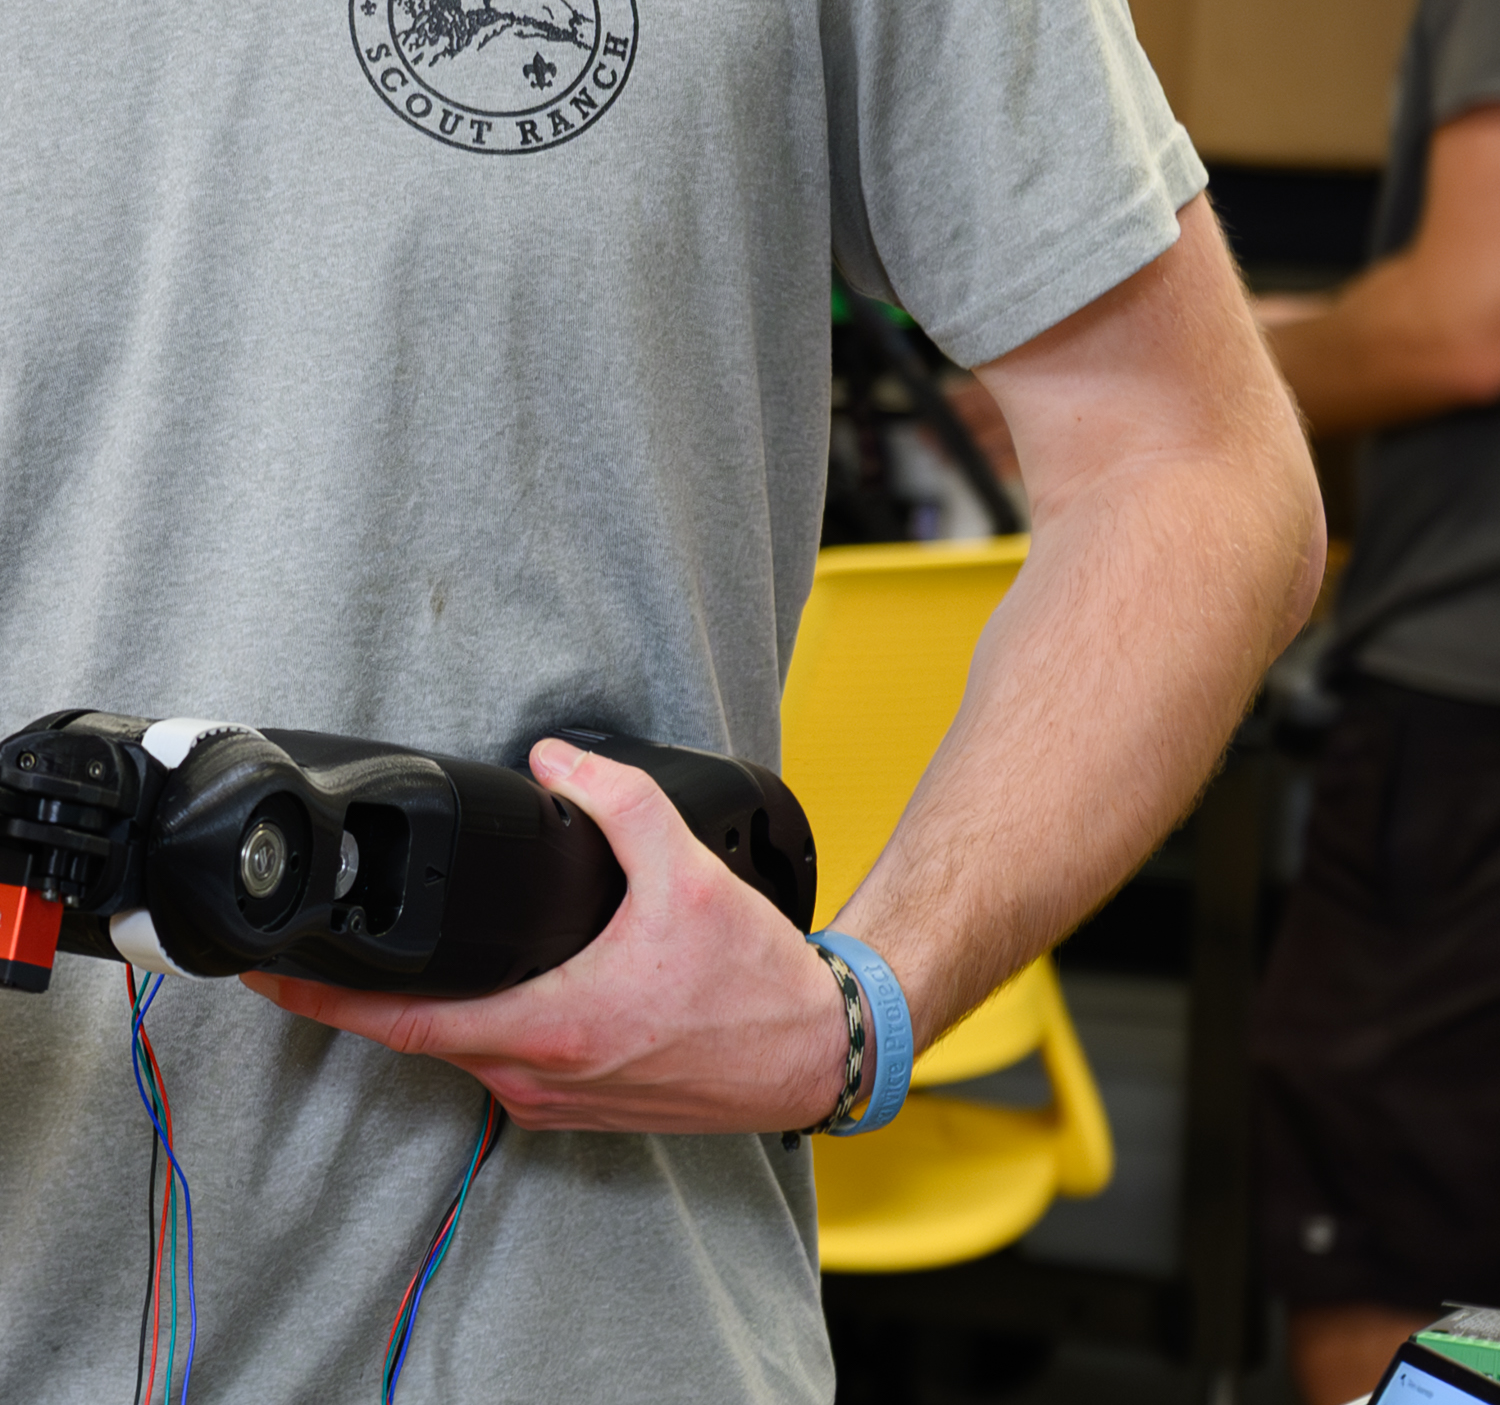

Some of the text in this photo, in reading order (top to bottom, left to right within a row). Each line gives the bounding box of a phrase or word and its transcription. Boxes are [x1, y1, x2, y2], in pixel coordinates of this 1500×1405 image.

[363, 31, 632, 146] SCOUT RANCH
[863, 963, 908, 1056] Project
